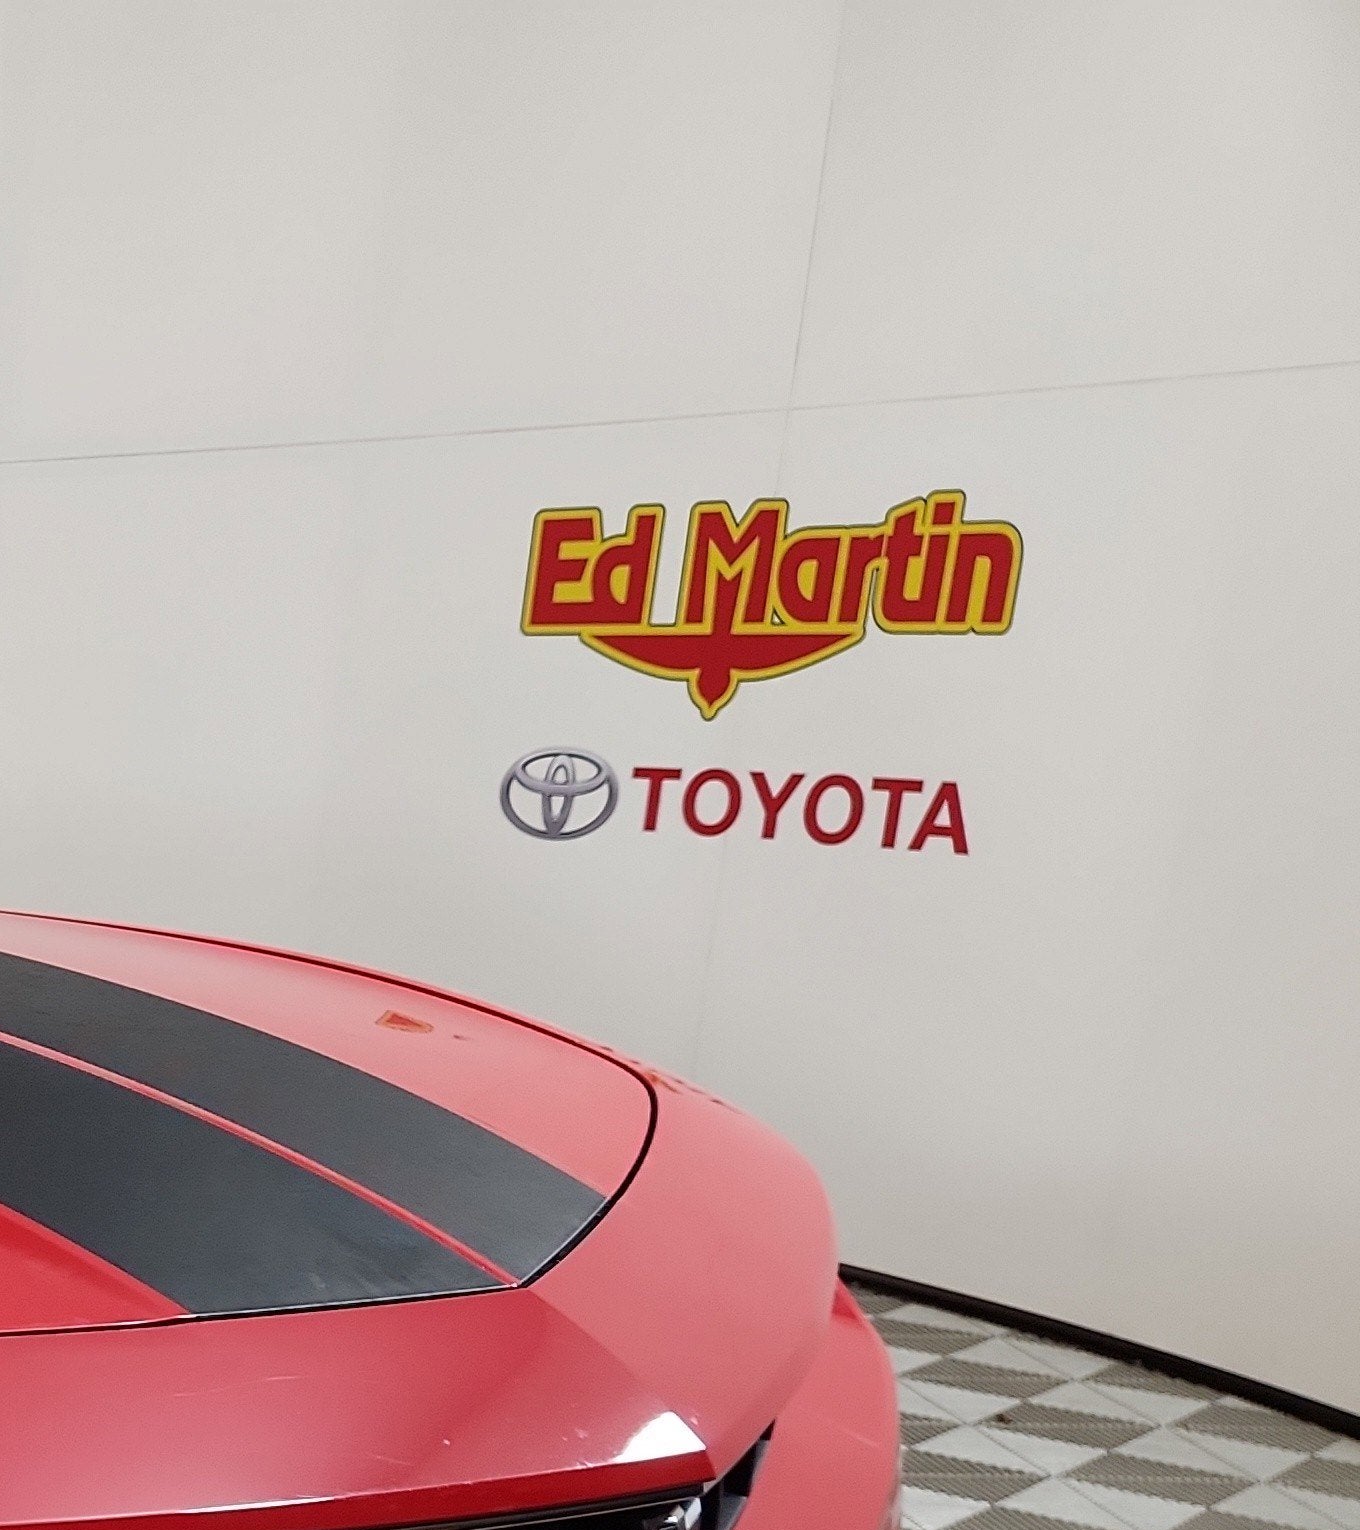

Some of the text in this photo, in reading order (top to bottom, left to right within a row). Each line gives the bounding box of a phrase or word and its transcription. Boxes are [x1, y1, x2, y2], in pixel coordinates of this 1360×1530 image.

[527, 499, 1017, 625] Ed Martin
[632, 766, 969, 855] TOYOTA
